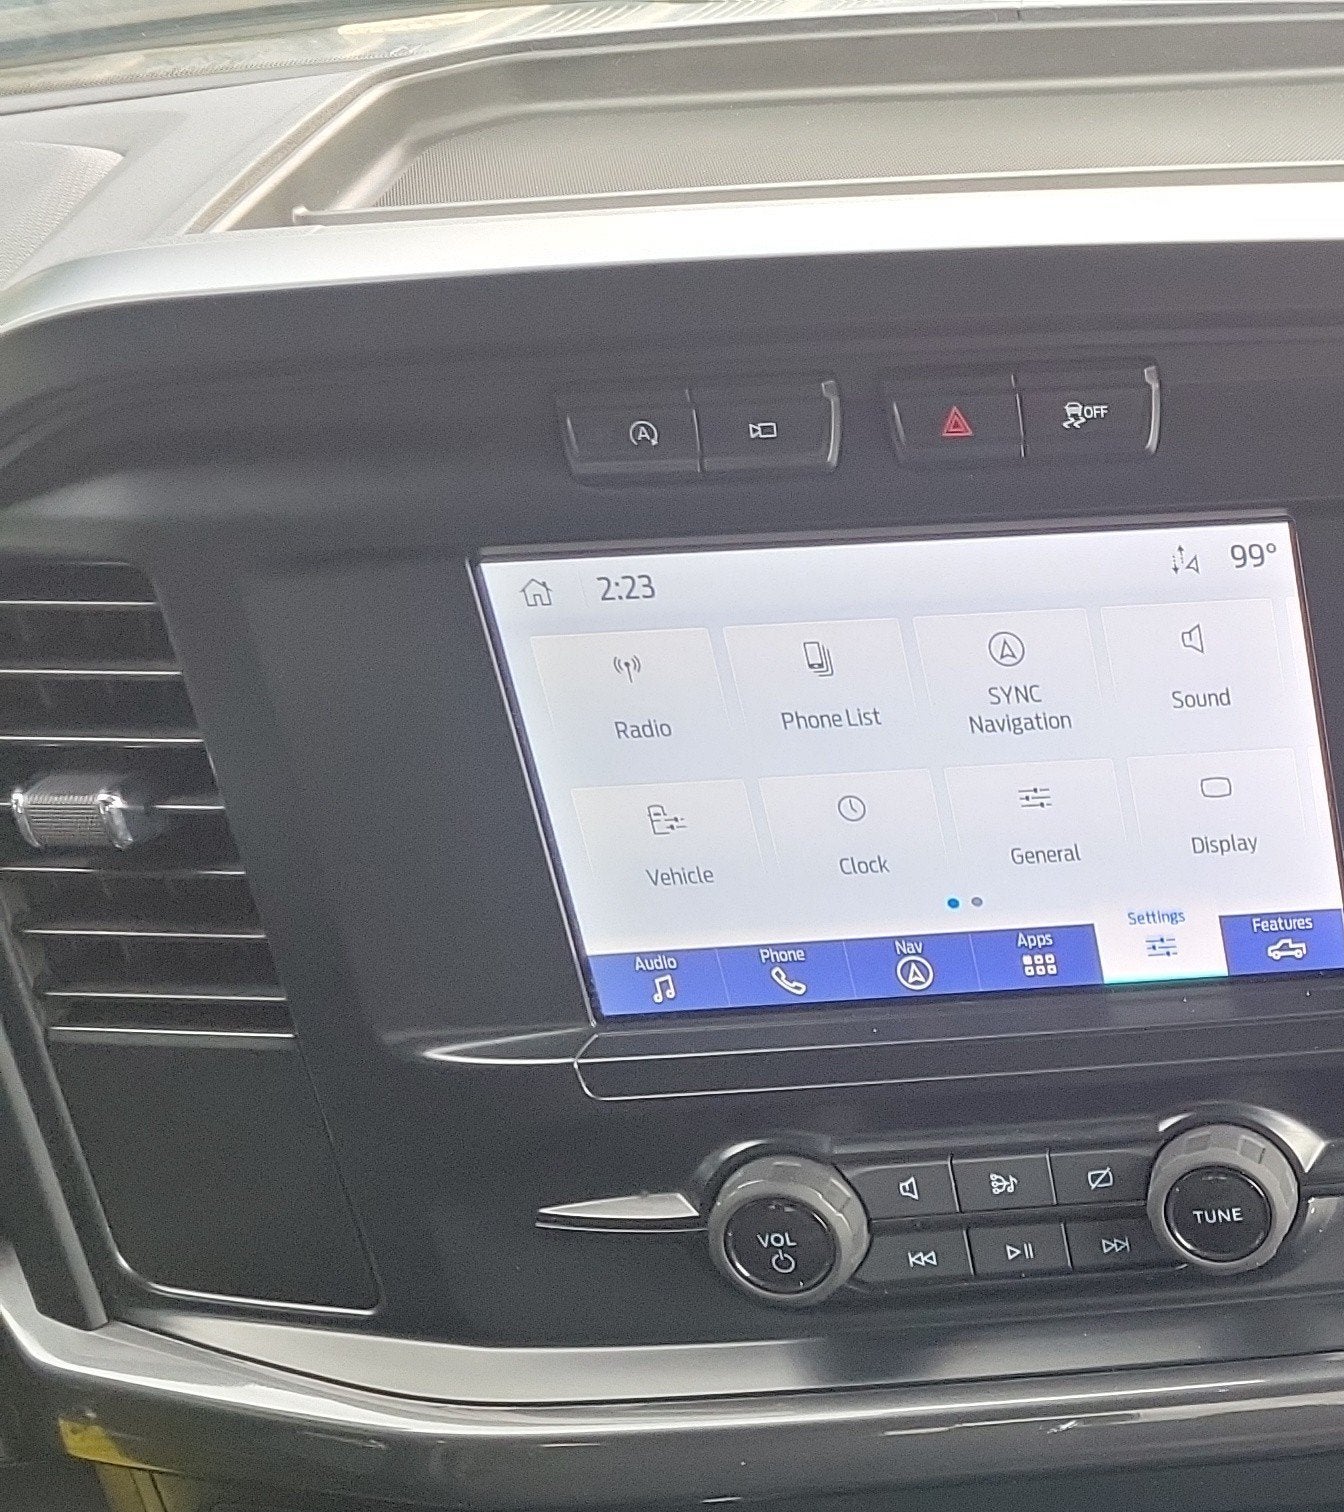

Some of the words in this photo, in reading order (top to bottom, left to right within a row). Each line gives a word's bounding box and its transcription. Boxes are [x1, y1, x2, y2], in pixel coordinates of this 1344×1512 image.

[1084, 405, 1108, 419] OFF
[1229, 543, 1277, 570] 99°
[597, 574, 656, 603] 2:23
[987, 684, 1042, 706] SYNC
[1171, 687, 1231, 709] Sound
[615, 719, 672, 739] Radio
[781, 709, 842, 731] Phone
[845, 707, 881, 728] List
[968, 710, 1072, 736] Navigation
[1009, 844, 1081, 866] General
[1191, 833, 1258, 857] Display
[839, 855, 890, 875] Clock
[646, 866, 714, 888] Vehicle
[1127, 908, 1186, 927] Settings
[1251, 914, 1313, 933] Features
[895, 938, 923, 955] Nav
[1017, 930, 1053, 951] Apps
[635, 954, 677, 973] Audio
[760, 945, 805, 965] Phone
[1193, 1208, 1244, 1226] TUNE
[756, 1232, 797, 1249] VOL
